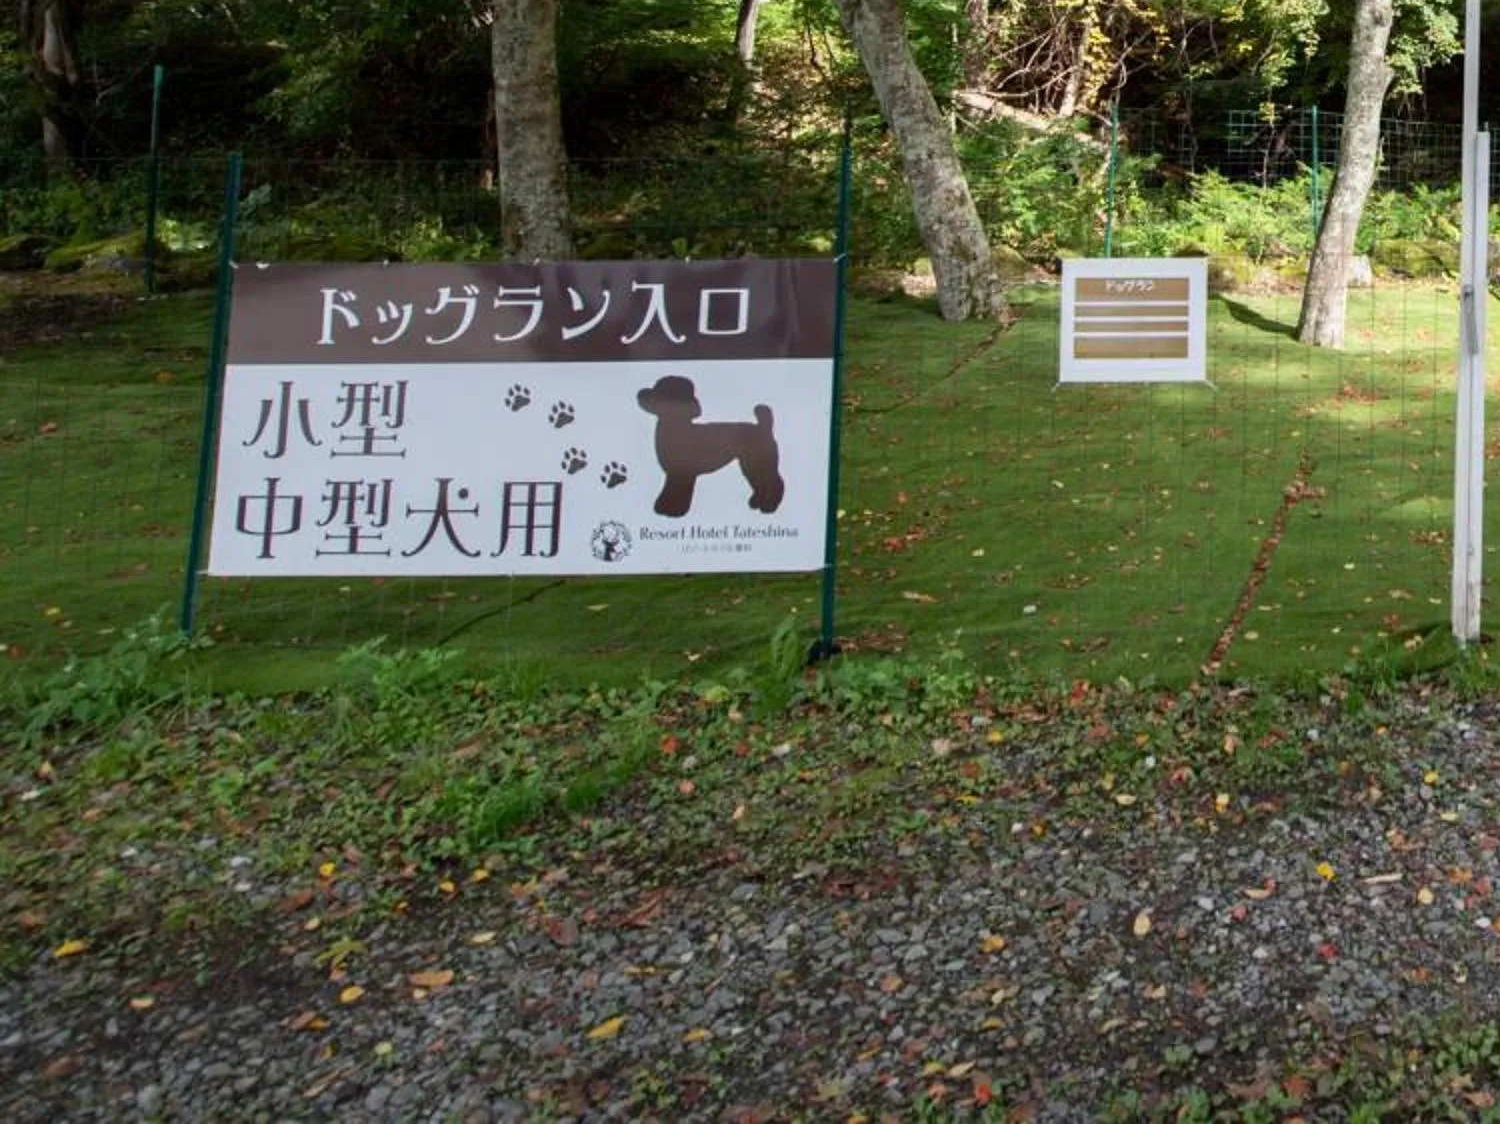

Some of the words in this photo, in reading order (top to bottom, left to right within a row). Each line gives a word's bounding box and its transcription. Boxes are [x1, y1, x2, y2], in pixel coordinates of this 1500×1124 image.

[318, 281, 750, 345] ドッグラン入口
[242, 380, 409, 459] 小型
[237, 477, 563, 558] 中型犬用
[639, 526, 686, 540] Resort
[690, 525, 730, 539] Hotel
